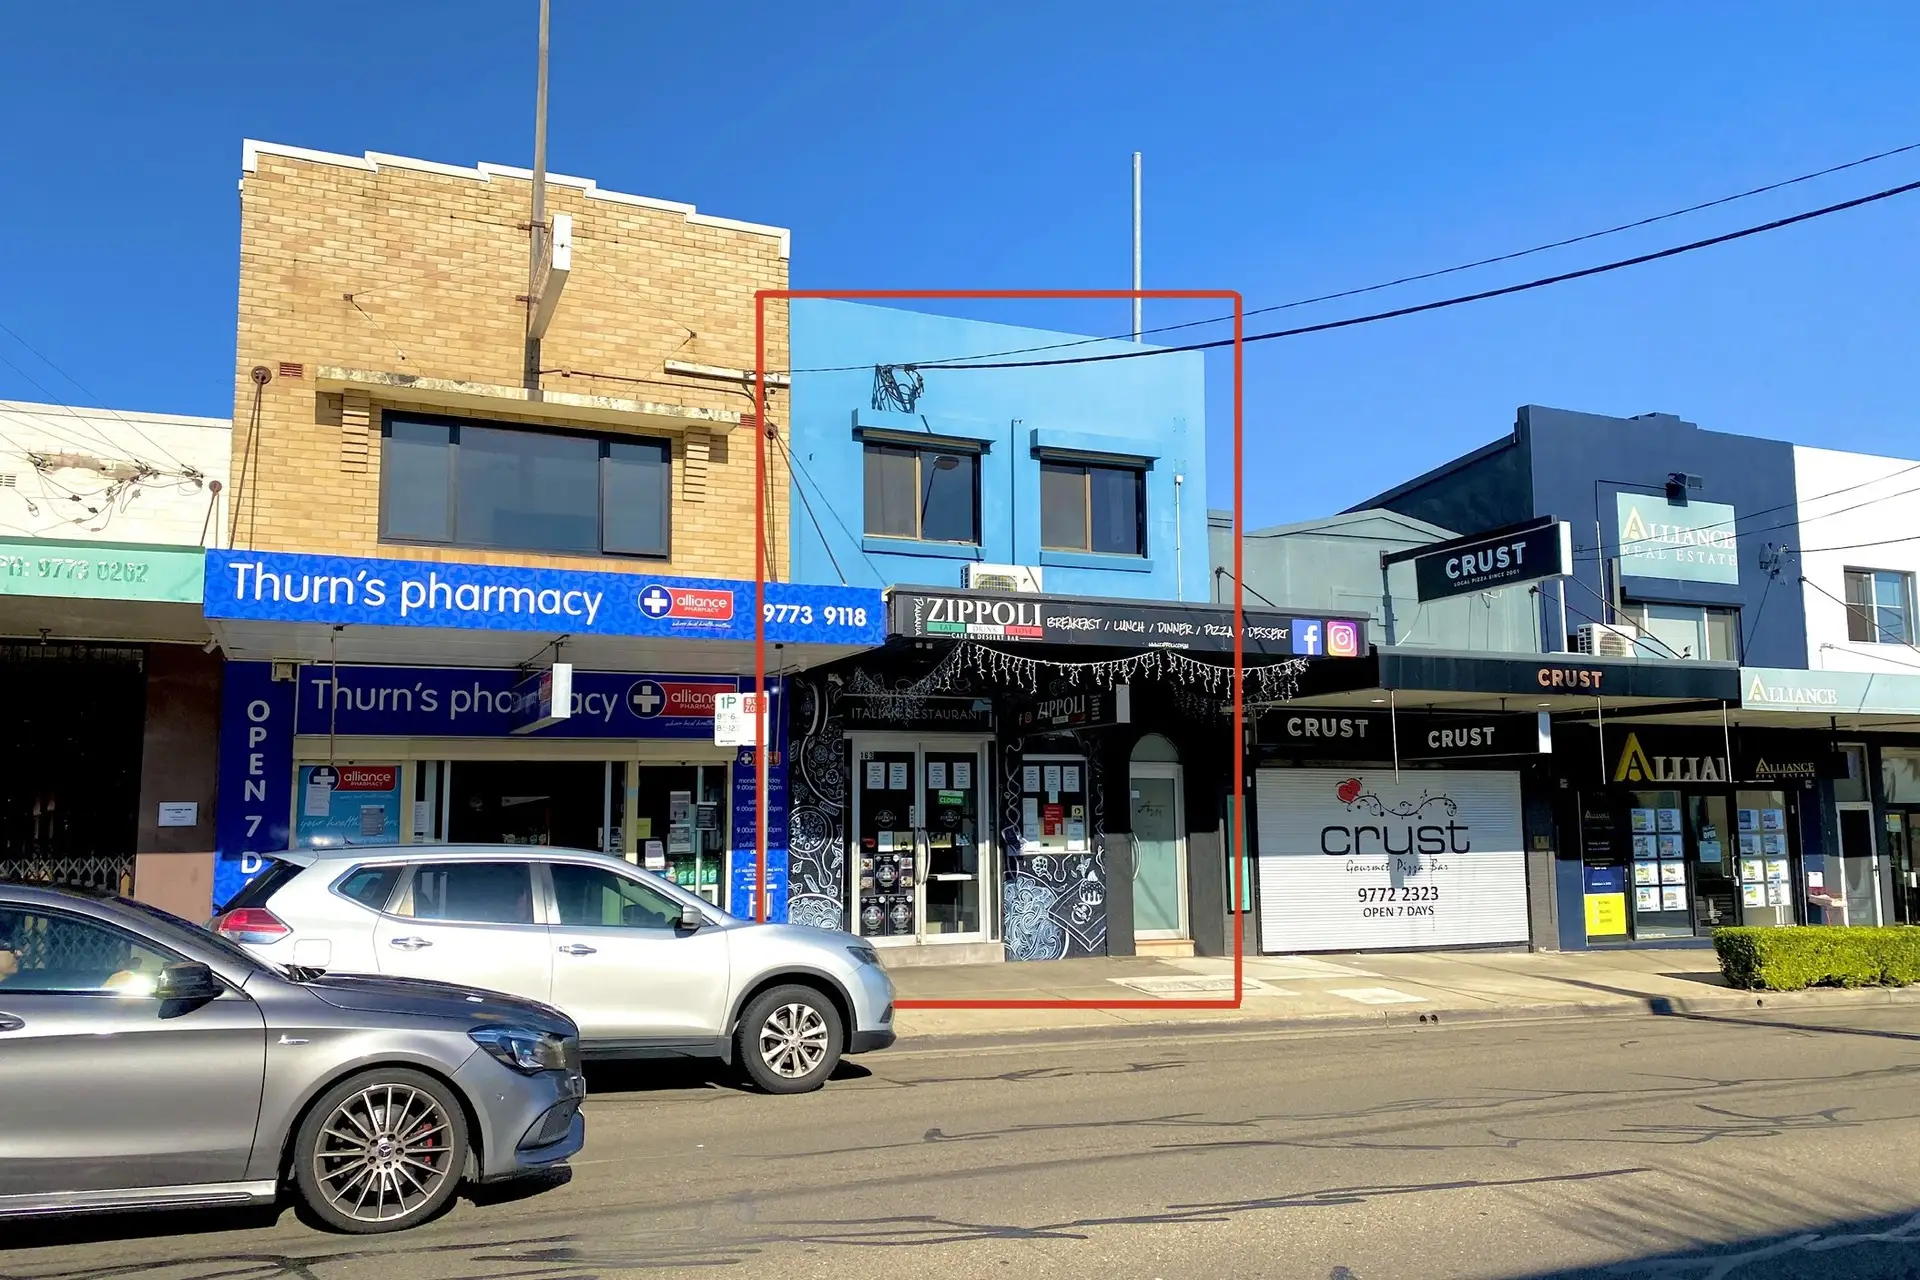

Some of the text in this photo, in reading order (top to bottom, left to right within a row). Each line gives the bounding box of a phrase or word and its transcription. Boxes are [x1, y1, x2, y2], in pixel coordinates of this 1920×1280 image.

[1621, 505, 1735, 549] ALLIANCE
[1445, 541, 1526, 579] CRUST
[1622, 544, 1737, 566] REAL ESTATE
[1489, 572, 1505, 580] SINCE
[1506, 568, 1520, 576] 2001
[229, 561, 602, 626] Thurn's pharmacy
[676, 594, 728, 609] alliance
[763, 603, 867, 627] 9773 9118
[926, 597, 1042, 627] ZIPPOLI
[972, 626, 998, 634] DRINK
[1046, 616, 1103, 631] BREAKFAST
[1113, 620, 1146, 634] LUNCH
[1157, 621, 1194, 635] DINNER
[1203, 624, 1235, 638] PIZZA
[1247, 627, 1290, 641] DESSERT
[1537, 668, 1603, 688] CRUST
[671, 688, 716, 704] allian
[1747, 673, 1838, 705] ALLIANCE
[311, 677, 439, 712] Thurn's
[450, 682, 619, 723] phaacy
[744, 705, 766, 713] ZOE
[746, 698, 765, 706] BU
[1036, 694, 1086, 720] ZIPPOLI
[1287, 717, 1368, 738] CRUST
[1428, 727, 1495, 748] CRUST
[244, 700, 271, 802] OPEN
[1613, 732, 1728, 782] ALLIA
[1755, 757, 1815, 774] ALLIANCE
[343, 771, 391, 782] alliance
[245, 815, 264, 838] 7
[1320, 819, 1471, 856] crust
[1430, 859, 1449, 871] Bar
[1357, 886, 1439, 902] 9772 2323
[1363, 906, 1435, 918] OPEN 7 DAYS
